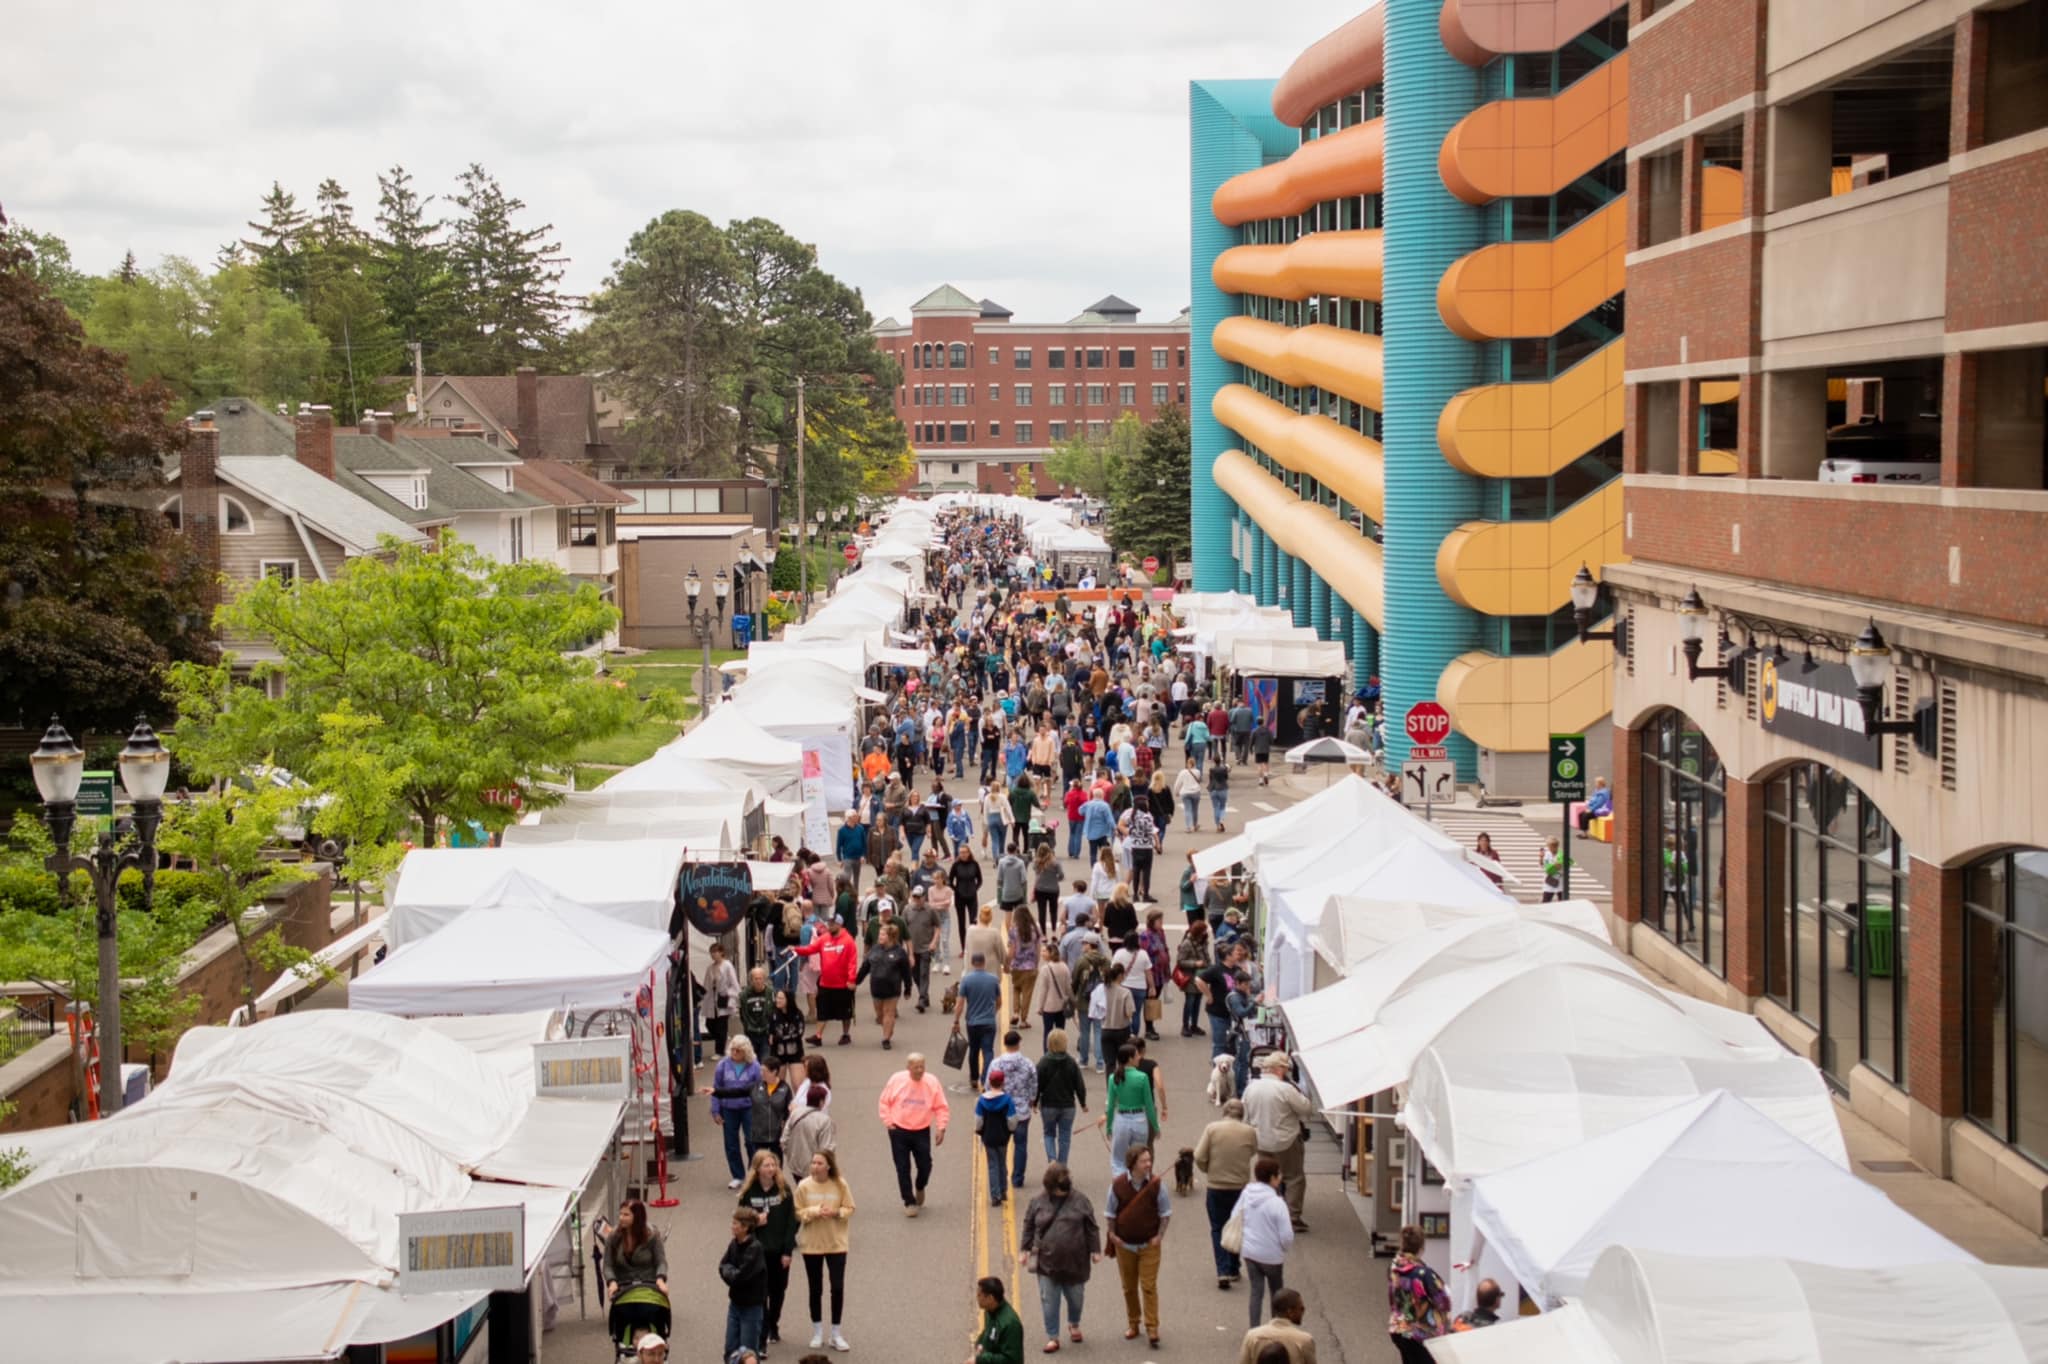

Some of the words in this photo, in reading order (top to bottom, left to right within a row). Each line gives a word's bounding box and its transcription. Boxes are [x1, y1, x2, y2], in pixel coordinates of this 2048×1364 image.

[1407, 715, 1448, 733] STOP
[1411, 748, 1427, 758] ALL
[1428, 748, 1446, 758] WAY
[1552, 780, 1584, 789] Charles
[1555, 790, 1581, 799] Street
